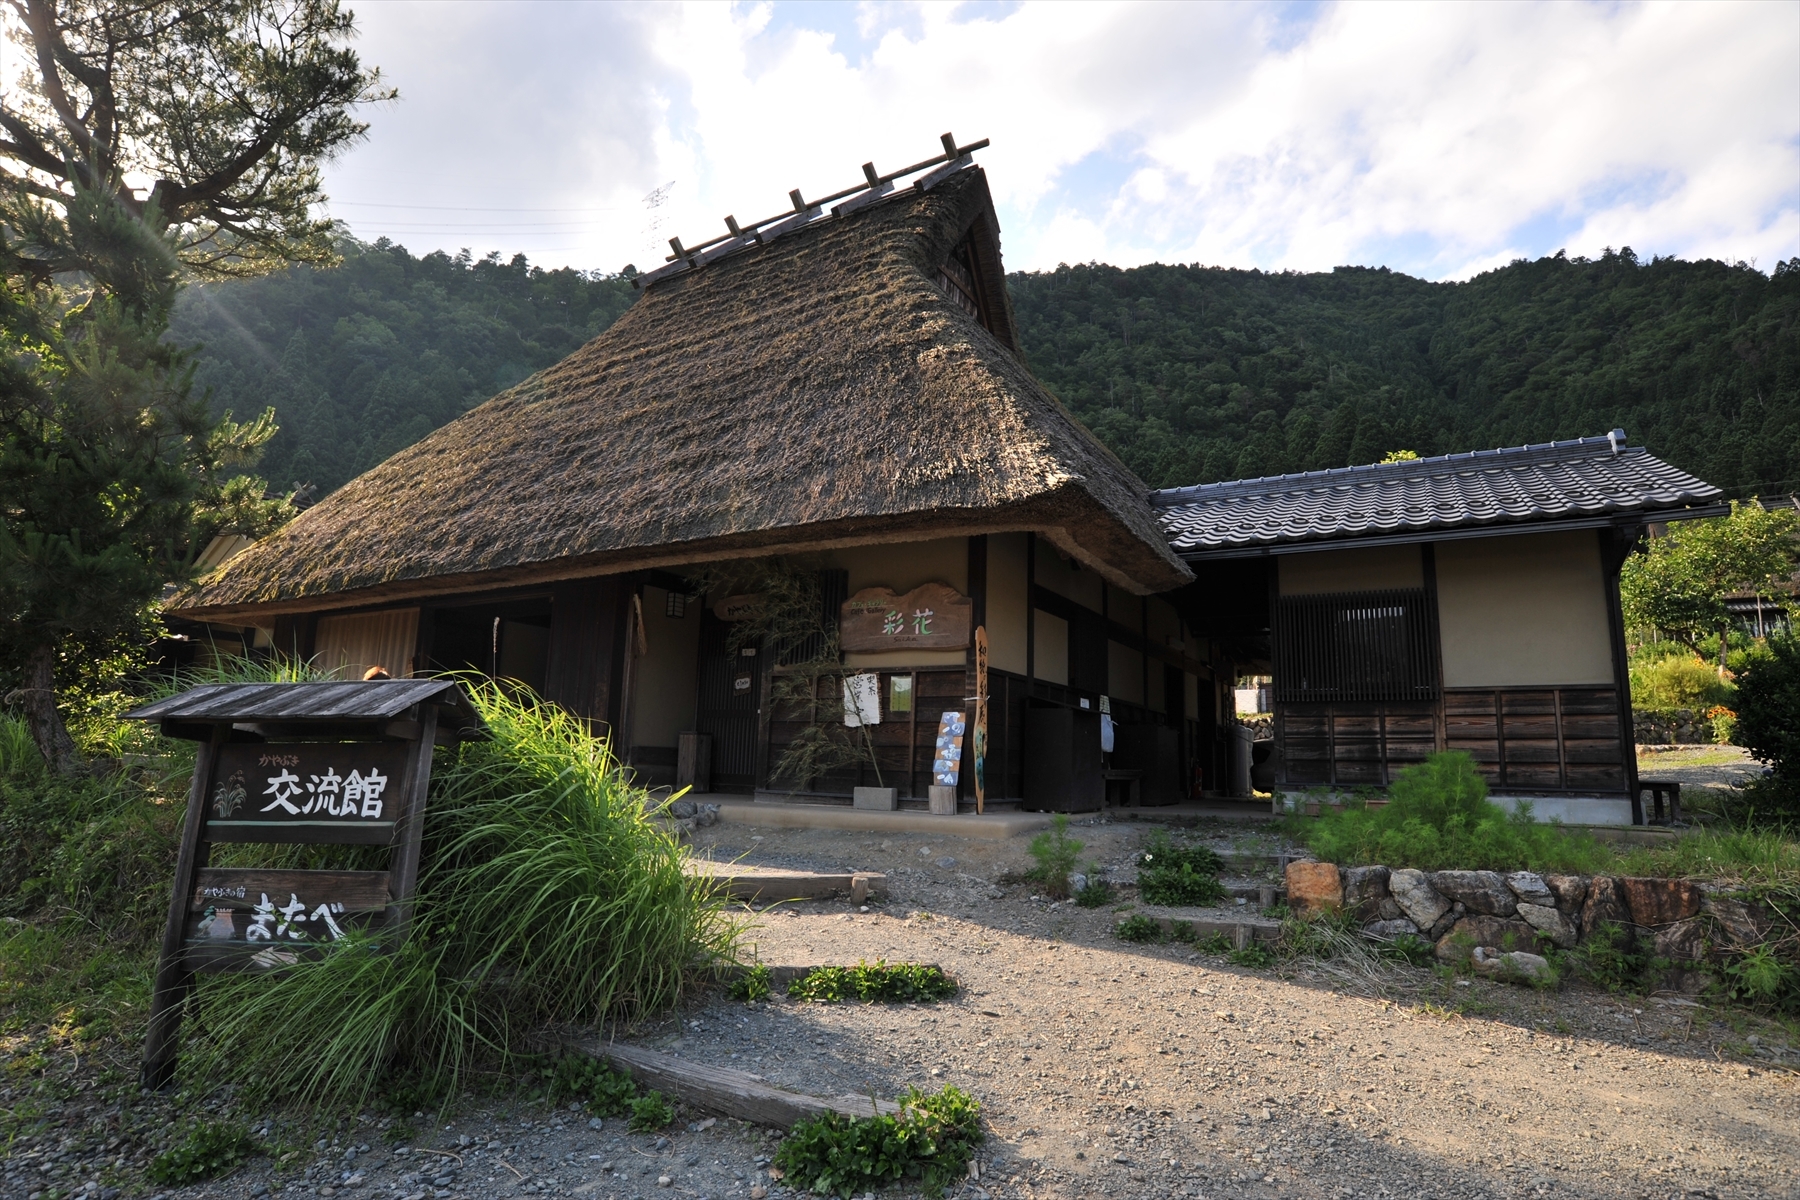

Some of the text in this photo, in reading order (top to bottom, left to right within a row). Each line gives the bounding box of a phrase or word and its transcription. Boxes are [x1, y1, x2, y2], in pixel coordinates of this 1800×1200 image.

[881, 607, 934, 635] 彩花
[866, 675, 876, 696] 喫茶
[258, 753, 300, 767] かやぶき
[259, 766, 388, 819] 交流館
[203, 885, 246, 899] かやぶきの宿
[245, 892, 352, 945] またべ
